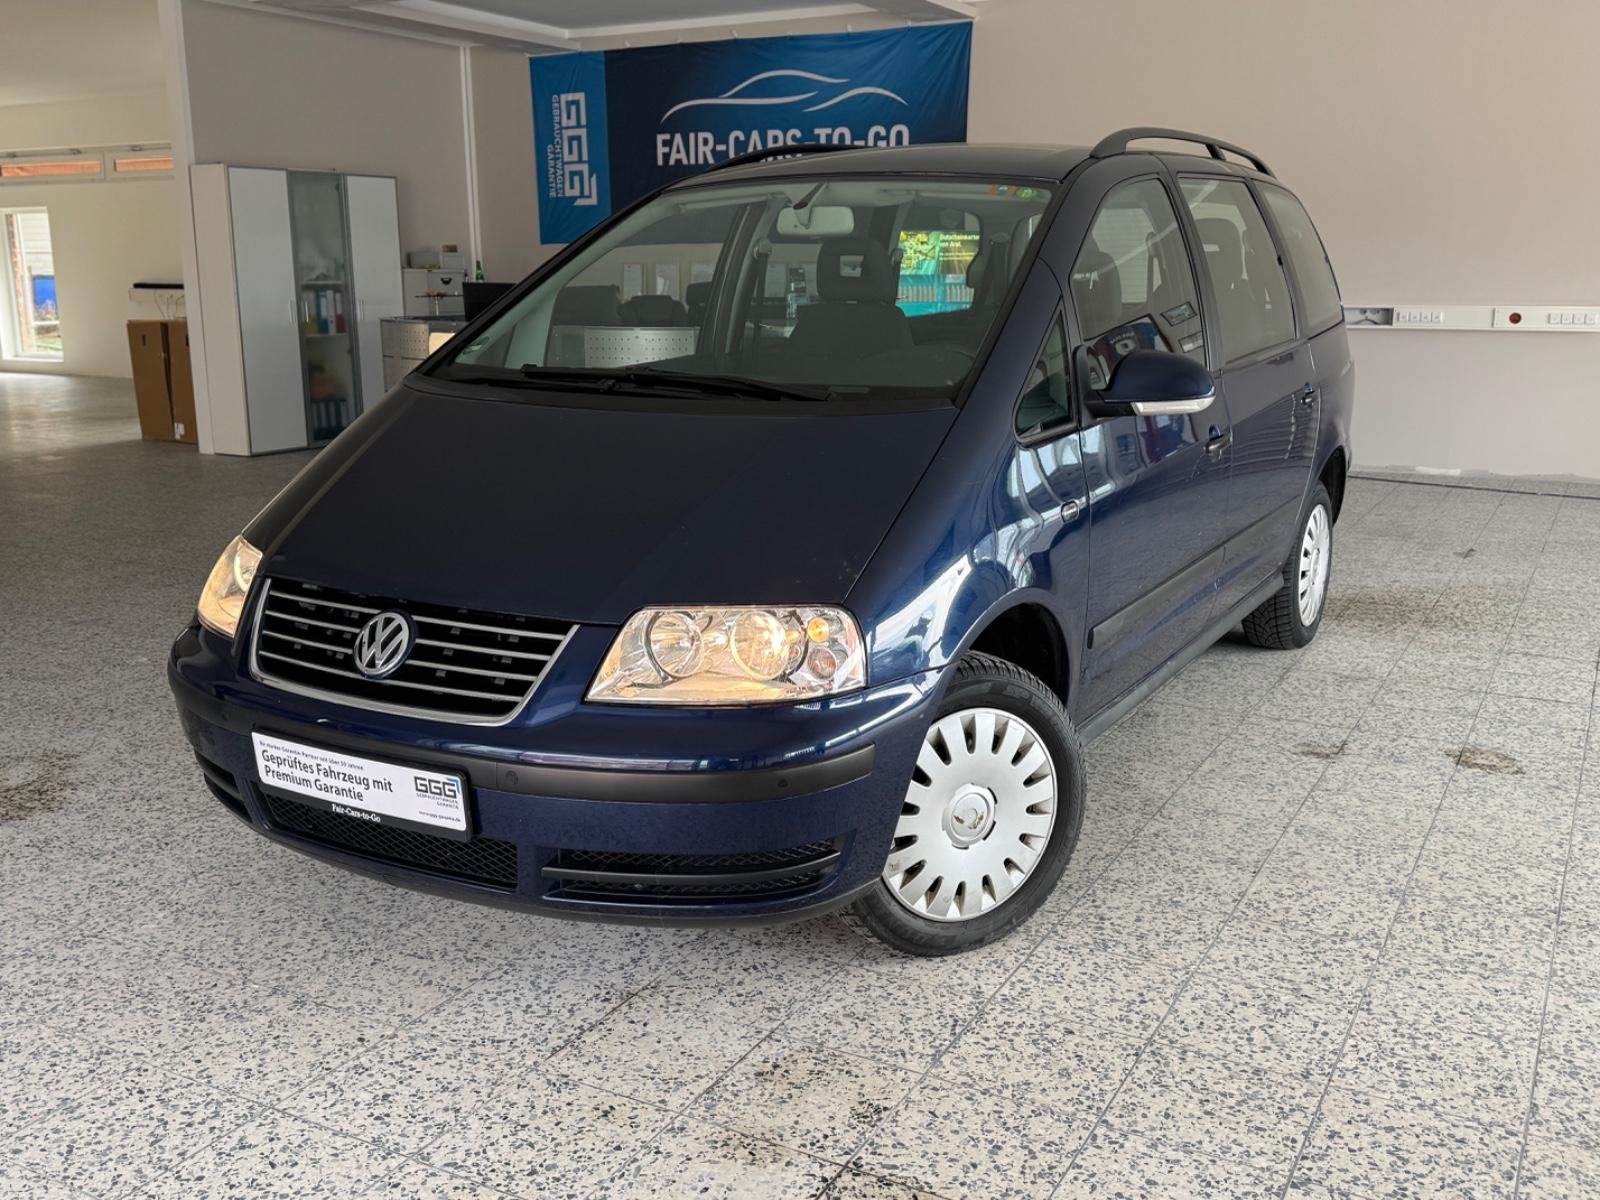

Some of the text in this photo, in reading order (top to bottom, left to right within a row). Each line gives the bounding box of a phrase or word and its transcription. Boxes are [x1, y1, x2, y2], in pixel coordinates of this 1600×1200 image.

[552, 94, 564, 198] GEBRAUCHTWAGEN
[547, 144, 557, 199] GARANTIE
[261, 749, 394, 792] Geprüftes Fahrzeug mit
[264, 765, 364, 802] Premium Garantie
[414, 776, 457, 799] GGG
[331, 803, 381, 823] Fair-Cars-to-Go
